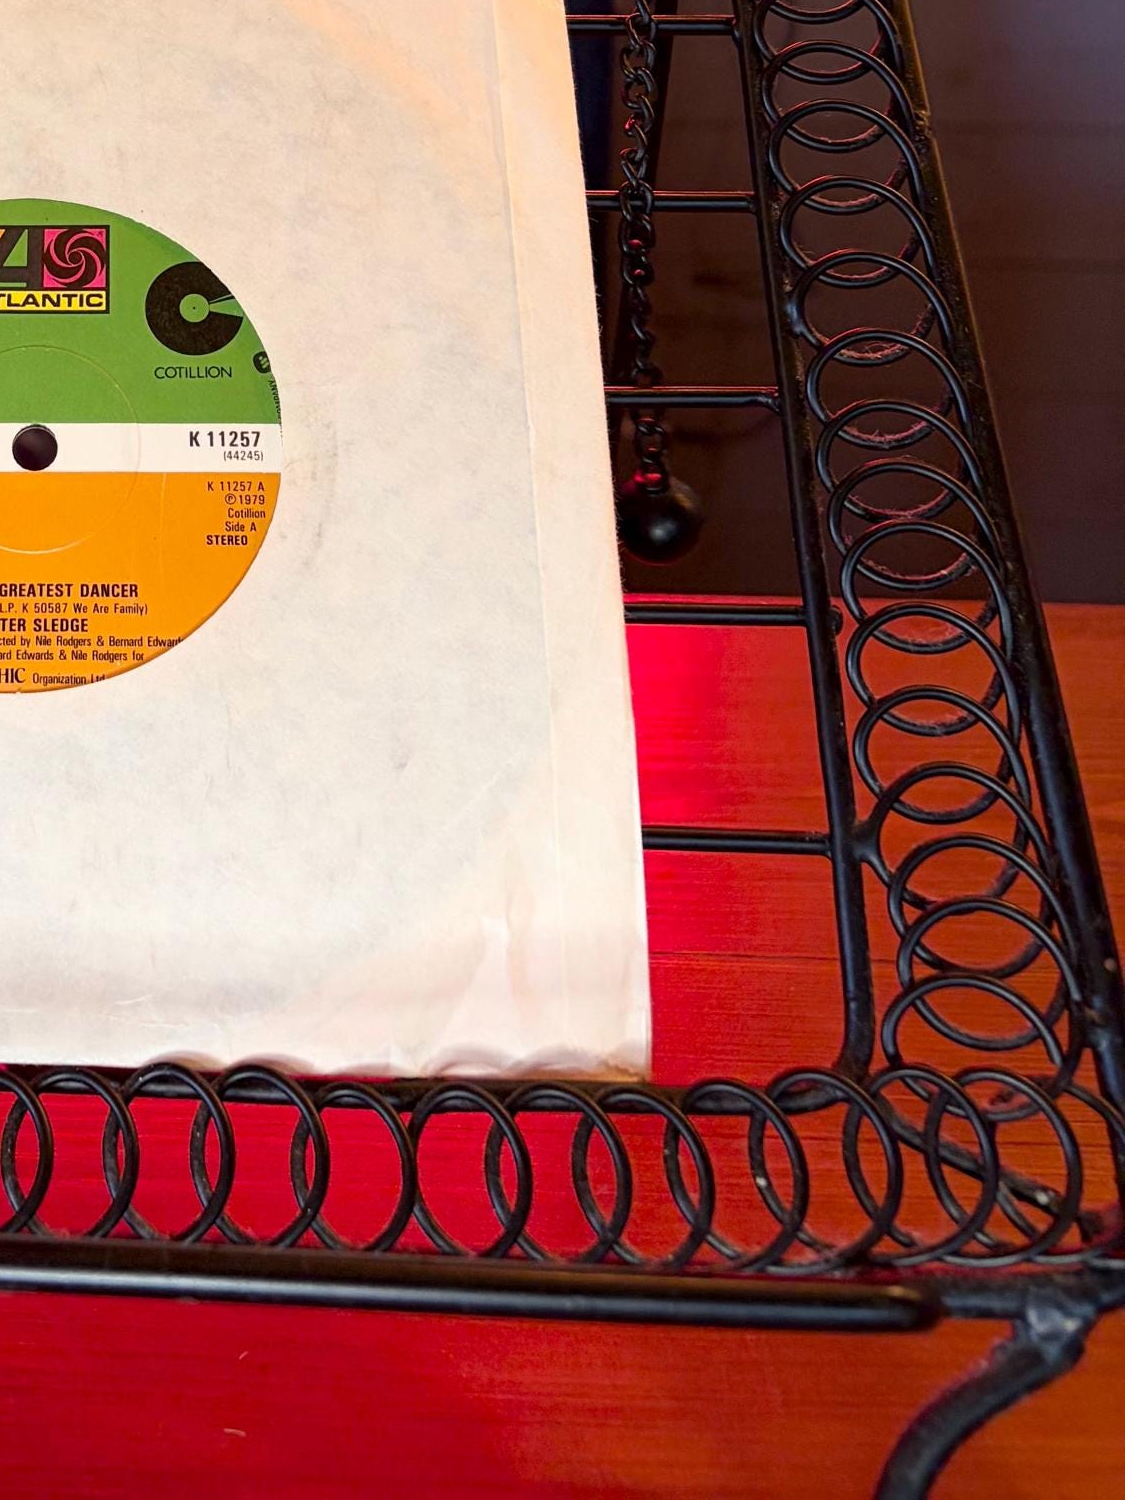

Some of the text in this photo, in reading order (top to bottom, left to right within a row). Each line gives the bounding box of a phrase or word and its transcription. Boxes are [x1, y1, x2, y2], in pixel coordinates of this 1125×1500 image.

[154, 366, 233, 379] COTILLION
[189, 431, 201, 447] K
[206, 431, 262, 447] 11257
[223, 450, 264, 462] (44245)
[207, 481, 265, 492] K 11257 A
[227, 507, 266, 519] Cotillion
[224, 521, 257, 532] Side A
[206, 534, 248, 546] STEREO
[0, 583, 73, 597] GREATEST
[80, 583, 138, 598] DANCER
[0, 602, 17, 614] L.P.
[22, 603, 29, 614] K
[34, 603, 68, 614] 50587
[73, 603, 88, 614] We
[92, 603, 109, 614] Are
[114, 603, 148, 616] Family)
[33, 618, 88, 632] SLEDGE
[21, 636, 31, 648] by
[35, 635, 52, 646] Nile
[56, 636, 92, 649] Rodgers
[96, 636, 105, 647] &
[109, 636, 143, 647] Bernard
[16, 649, 54, 660] Edwards
[58, 650, 67, 661] &
[71, 650, 88, 661] Nile
[92, 650, 128, 663] Rodgers
[132, 650, 144, 661] for
[32, 673, 86, 687] Organization
